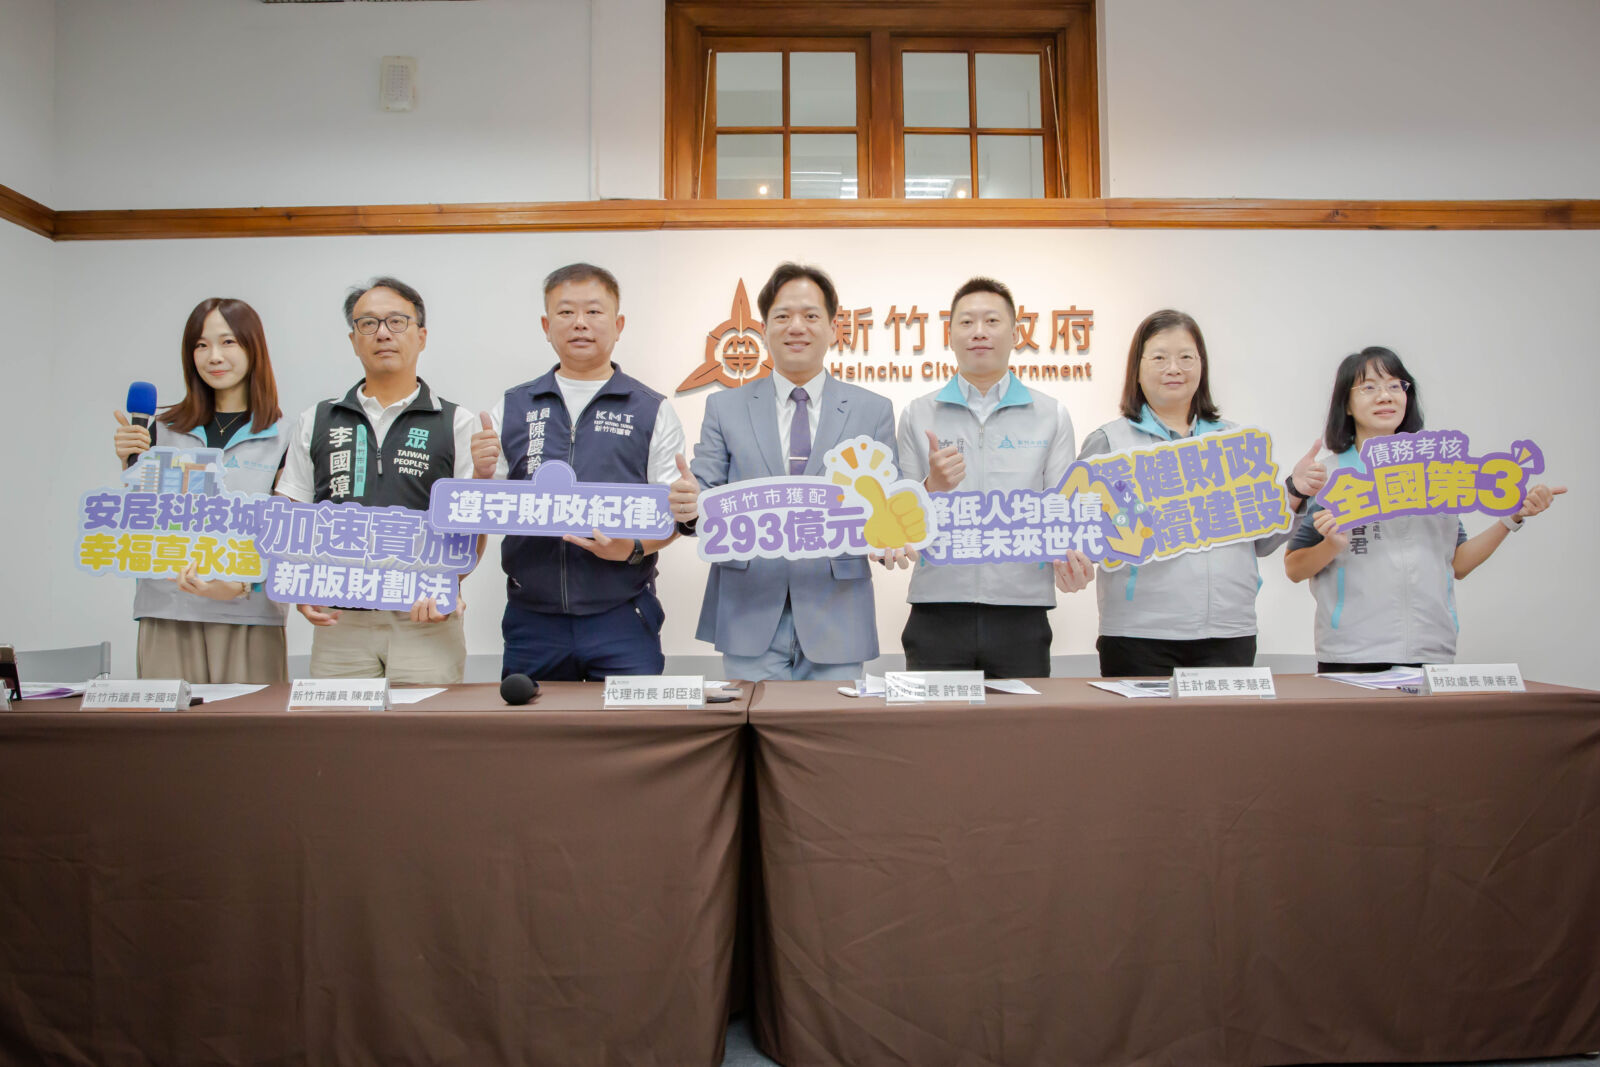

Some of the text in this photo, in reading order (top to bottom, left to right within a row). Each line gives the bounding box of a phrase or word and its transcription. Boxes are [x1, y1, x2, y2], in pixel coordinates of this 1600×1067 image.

[830, 305, 1094, 352] 新竹政府
[831, 361, 1092, 379] Hsinchu City ernment
[595, 410, 634, 424] KMT
[329, 426, 353, 498] 李國璋
[393, 457, 429, 470] PEOPLE'S
[397, 449, 430, 461] TAIWAN
[1367, 436, 1462, 467] 債務考核
[398, 467, 424, 478] PARTY
[719, 487, 827, 514] 新竹市獲配
[1324, 458, 1523, 526] 全國第3
[83, 492, 264, 535] 安居科技城
[448, 490, 658, 529] 遵守財政紀律
[1148, 481, 1287, 553] 續建設
[259, 502, 476, 567] 加速實施
[703, 506, 868, 555] 293億元
[80, 533, 262, 576] 幸福真永遠
[273, 561, 452, 607] 新版財劃法
[293, 690, 348, 701] 新竹市議員
[606, 688, 658, 700] 代理市長
[1178, 678, 1271, 692] 主計處長 李慧君
[1432, 676, 1480, 687] 財政處長
[86, 691, 140, 703] 新竹市議員
